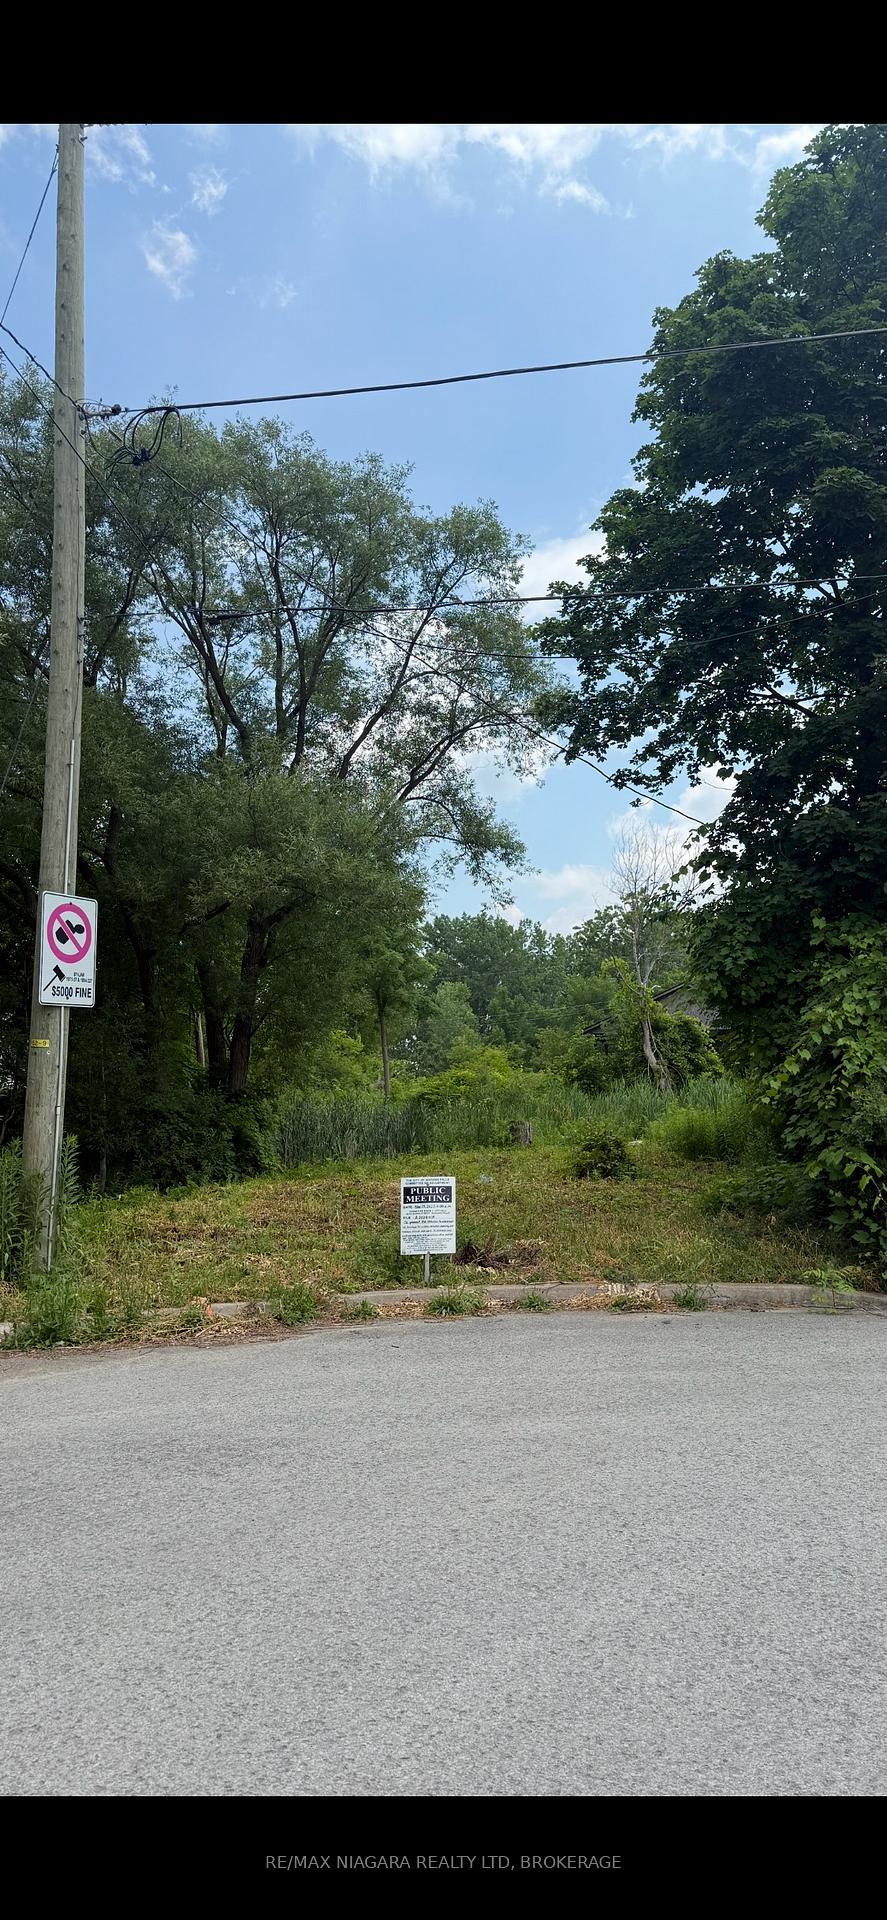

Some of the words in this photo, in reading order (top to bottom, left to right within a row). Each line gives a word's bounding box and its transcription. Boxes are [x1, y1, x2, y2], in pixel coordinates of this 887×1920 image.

[51, 986, 73, 997] $5000
[75, 987, 92, 998] FINE
[410, 1187, 446, 1195] PUBLIC
